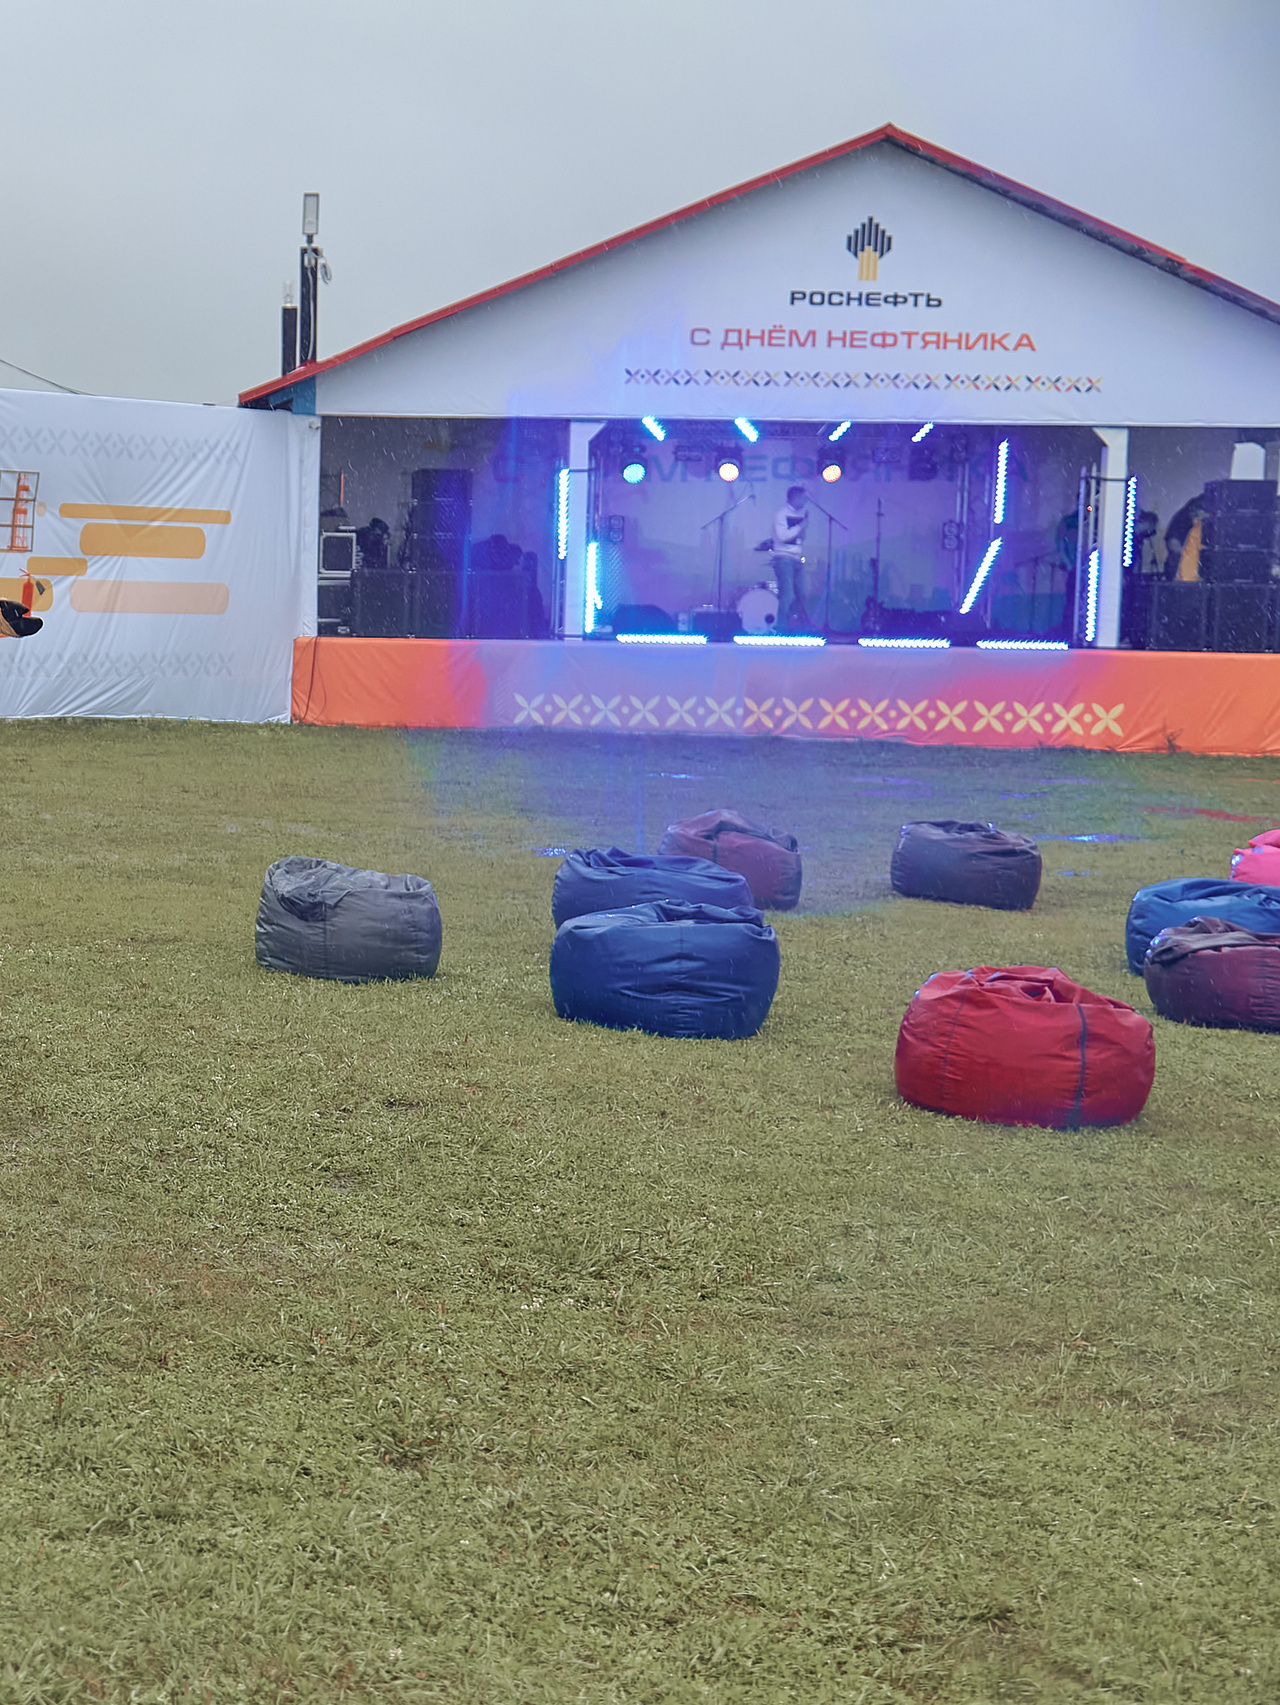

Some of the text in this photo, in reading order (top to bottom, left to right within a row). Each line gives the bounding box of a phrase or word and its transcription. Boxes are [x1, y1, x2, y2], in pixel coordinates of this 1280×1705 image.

[789, 289, 944, 308] РОСНЕФТЬ
[690, 324, 1037, 352] С ДНЁМ НЕФТЯНИКА
